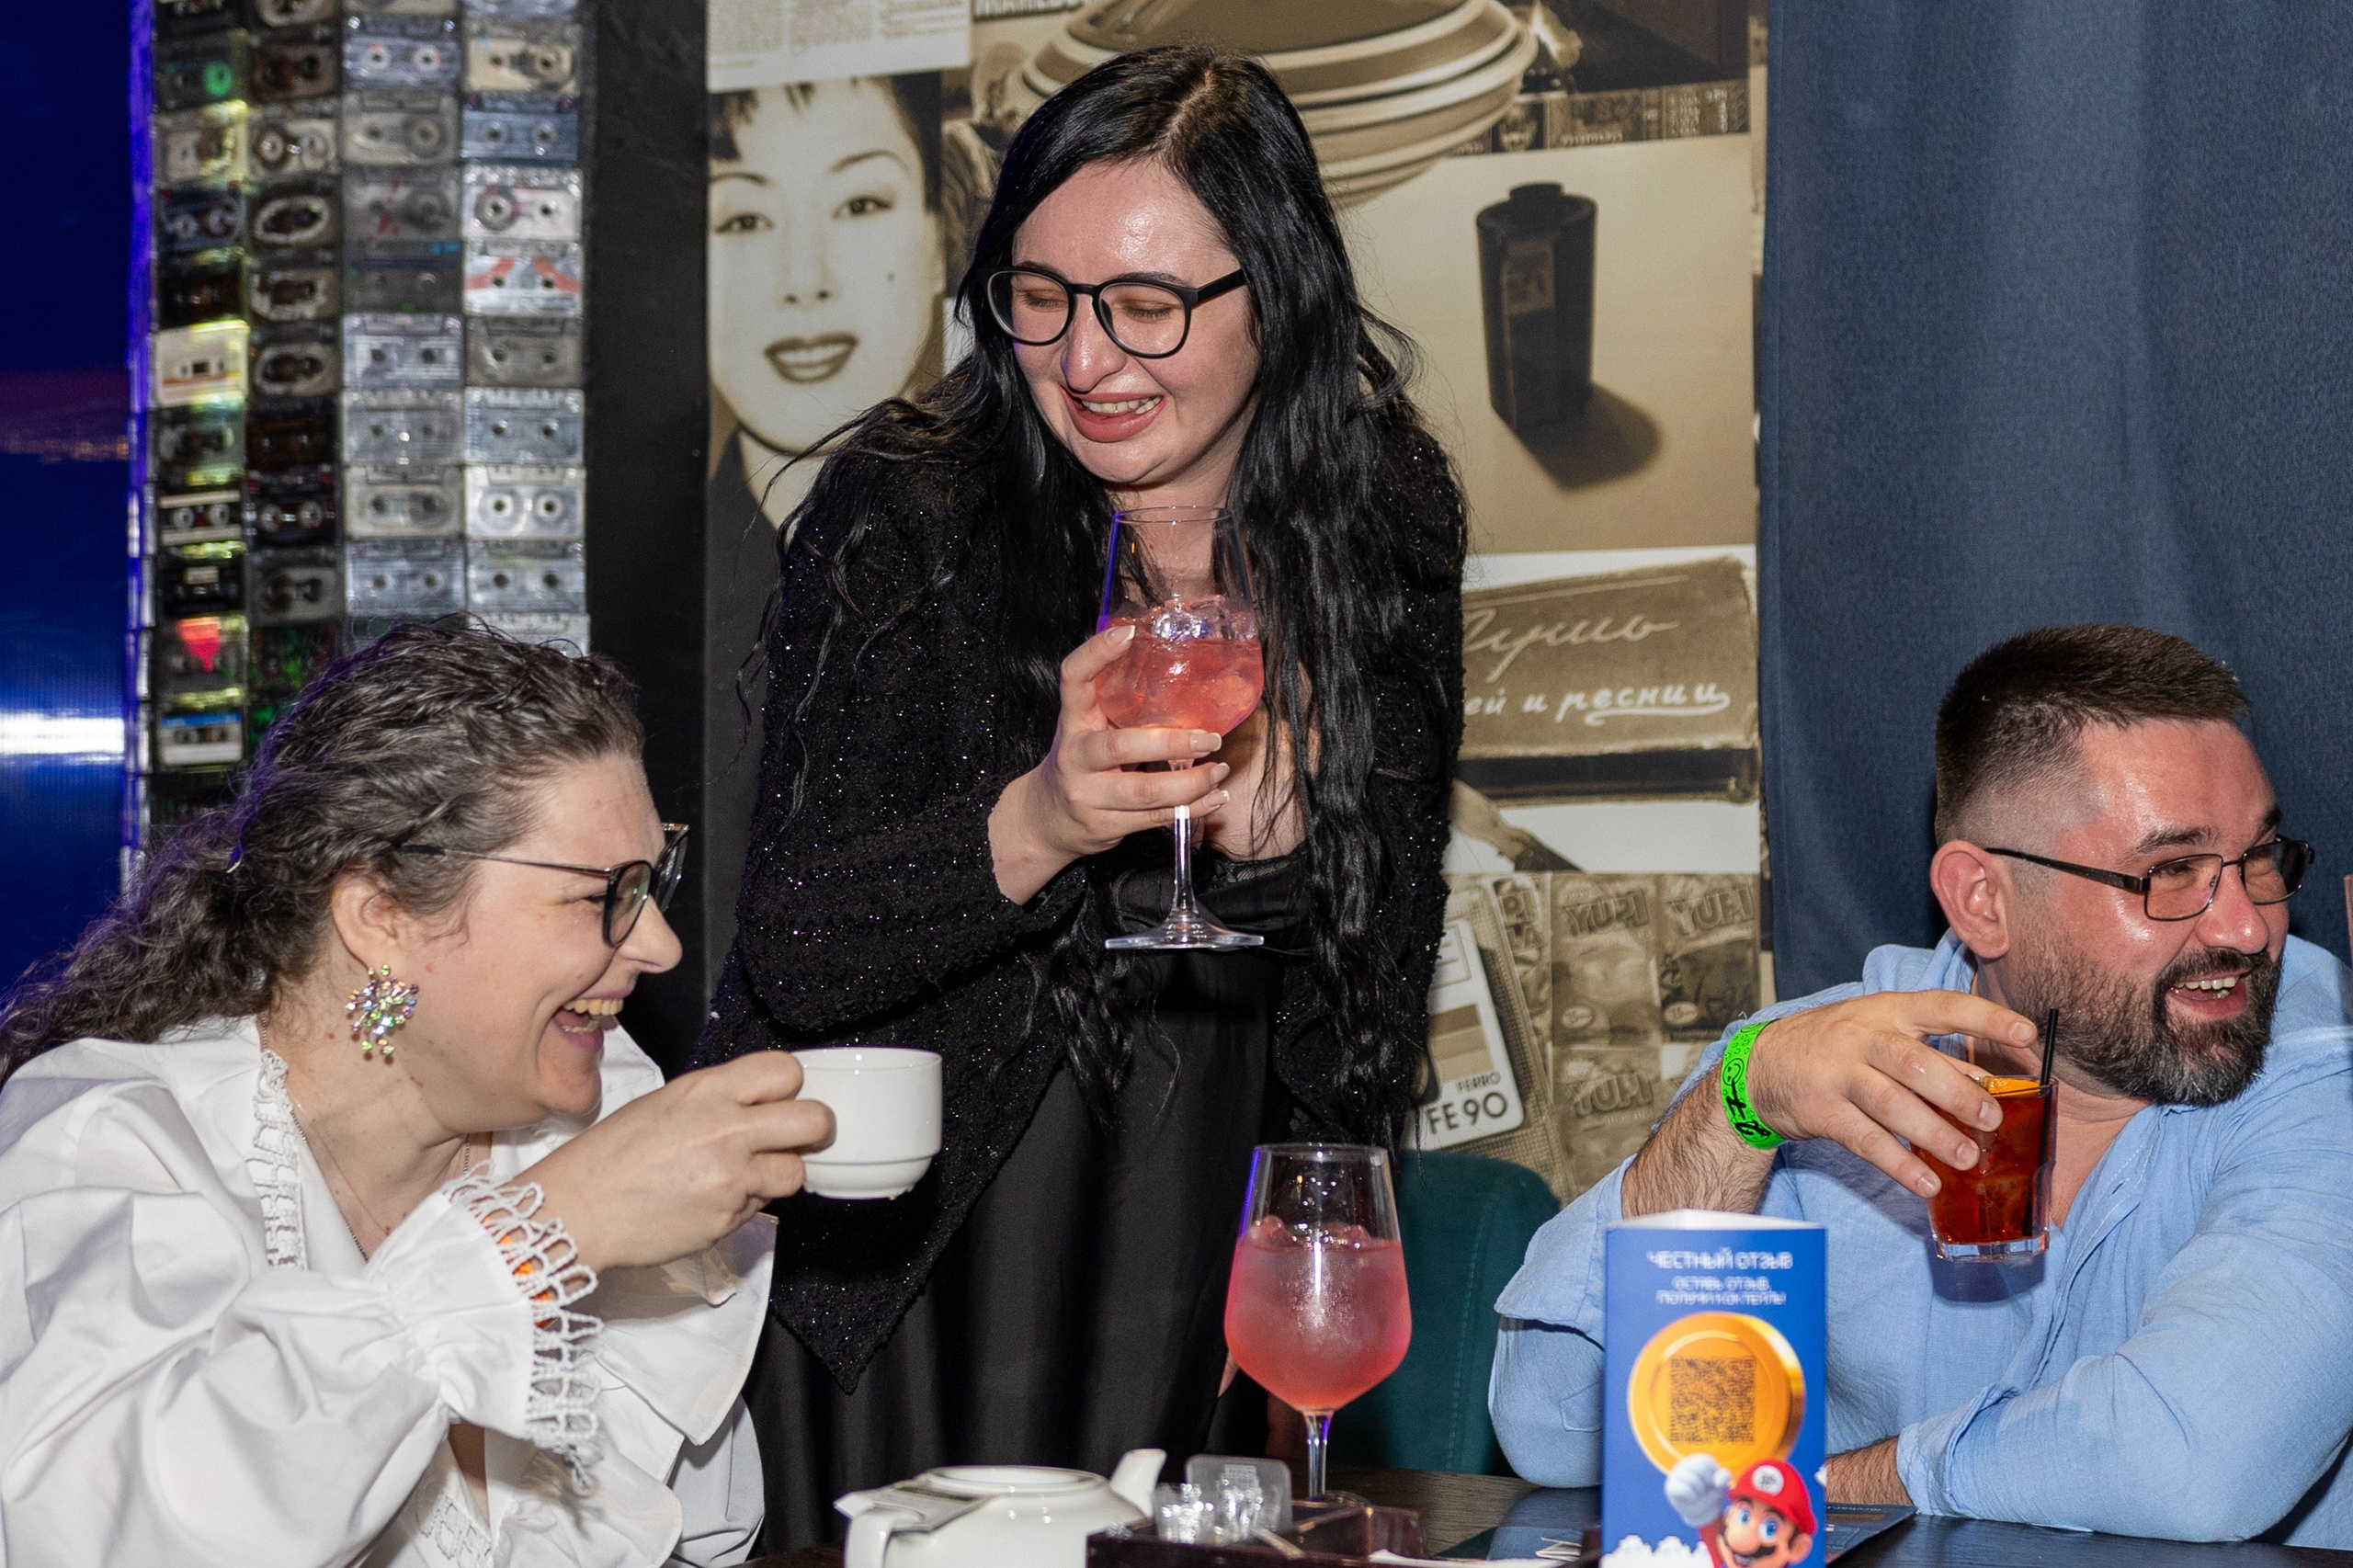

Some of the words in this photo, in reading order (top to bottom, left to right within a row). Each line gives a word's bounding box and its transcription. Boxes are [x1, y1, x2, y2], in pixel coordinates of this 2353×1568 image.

[1521, 694, 1549, 713] и
[1457, 1072, 1501, 1093] FERRO
[1646, 1246, 1733, 1269] ЧЕСТНЫЙ
[1734, 1251, 1793, 1269] ОТЗЫВ
[1672, 1275, 1723, 1291] ОСТАВЬ
[1656, 1290, 1715, 1305] ПОЛУЧИ
[1716, 1290, 1787, 1306] КОКТЕЙЛЬ!
